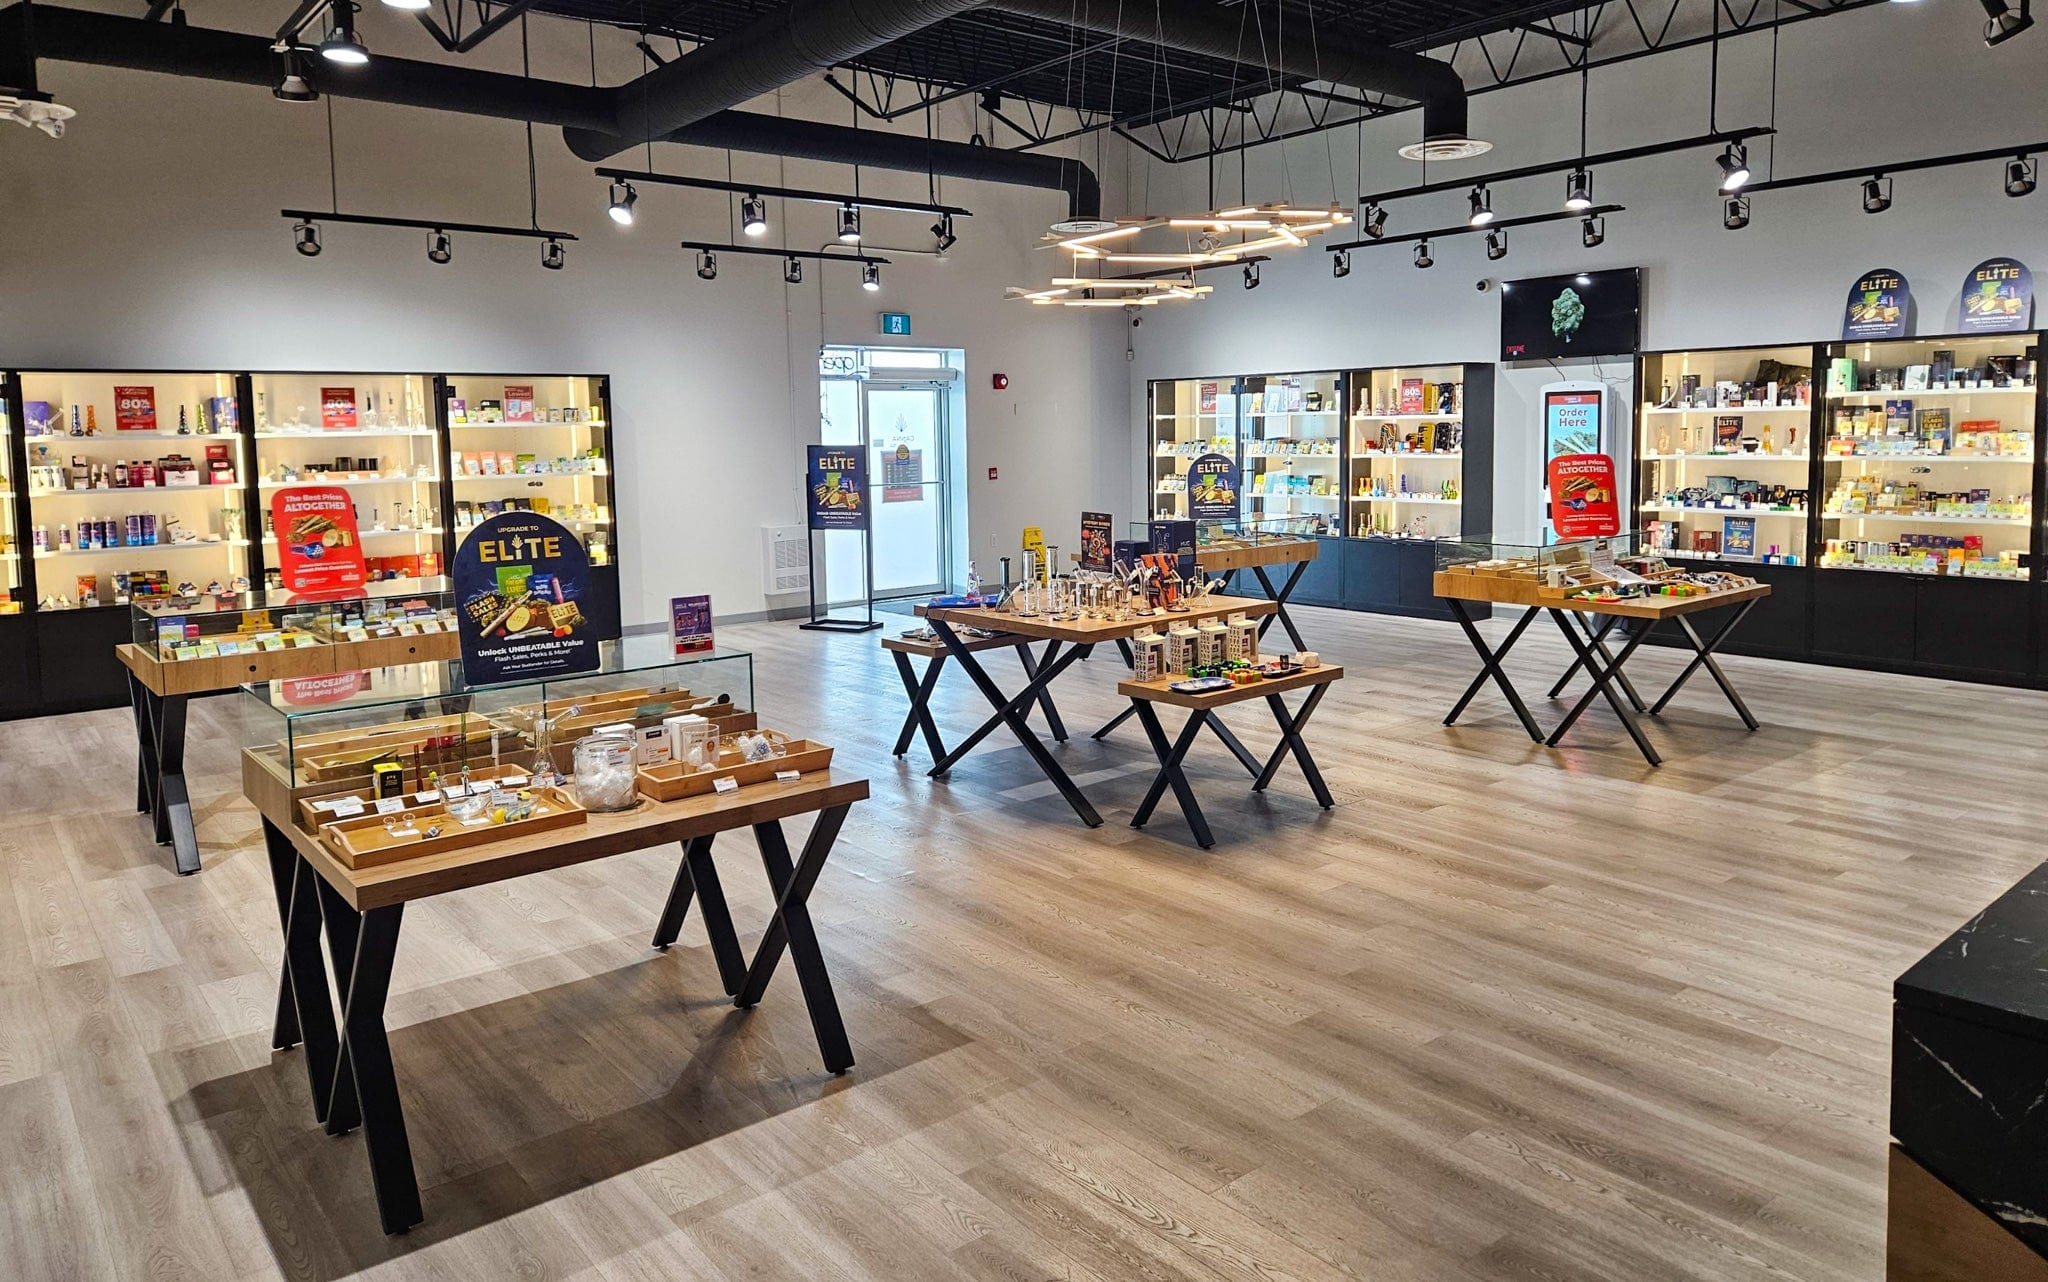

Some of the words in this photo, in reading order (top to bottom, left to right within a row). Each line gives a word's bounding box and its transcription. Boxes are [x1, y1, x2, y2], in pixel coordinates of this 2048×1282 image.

[1976, 268, 2019, 281] ELITE
[1860, 278, 1898, 291] ELITE
[121, 398, 150, 409] 80%
[1559, 408, 1588, 417] Order
[1559, 417, 1587, 427] Here
[819, 456, 856, 470] ELITE
[1197, 462, 1230, 473] ELITE
[1557, 466, 1608, 474] ALTOGETHER
[322, 493, 343, 501] Prices
[284, 502, 346, 513] ALTOGETHER
[498, 525, 528, 533] UPGRADE
[479, 535, 562, 563] ELITE
[468, 595, 497, 611] FLASH
[477, 648, 507, 657] Unlock
[508, 641, 560, 653] UNBEATABLE
[562, 639, 584, 647] Value
